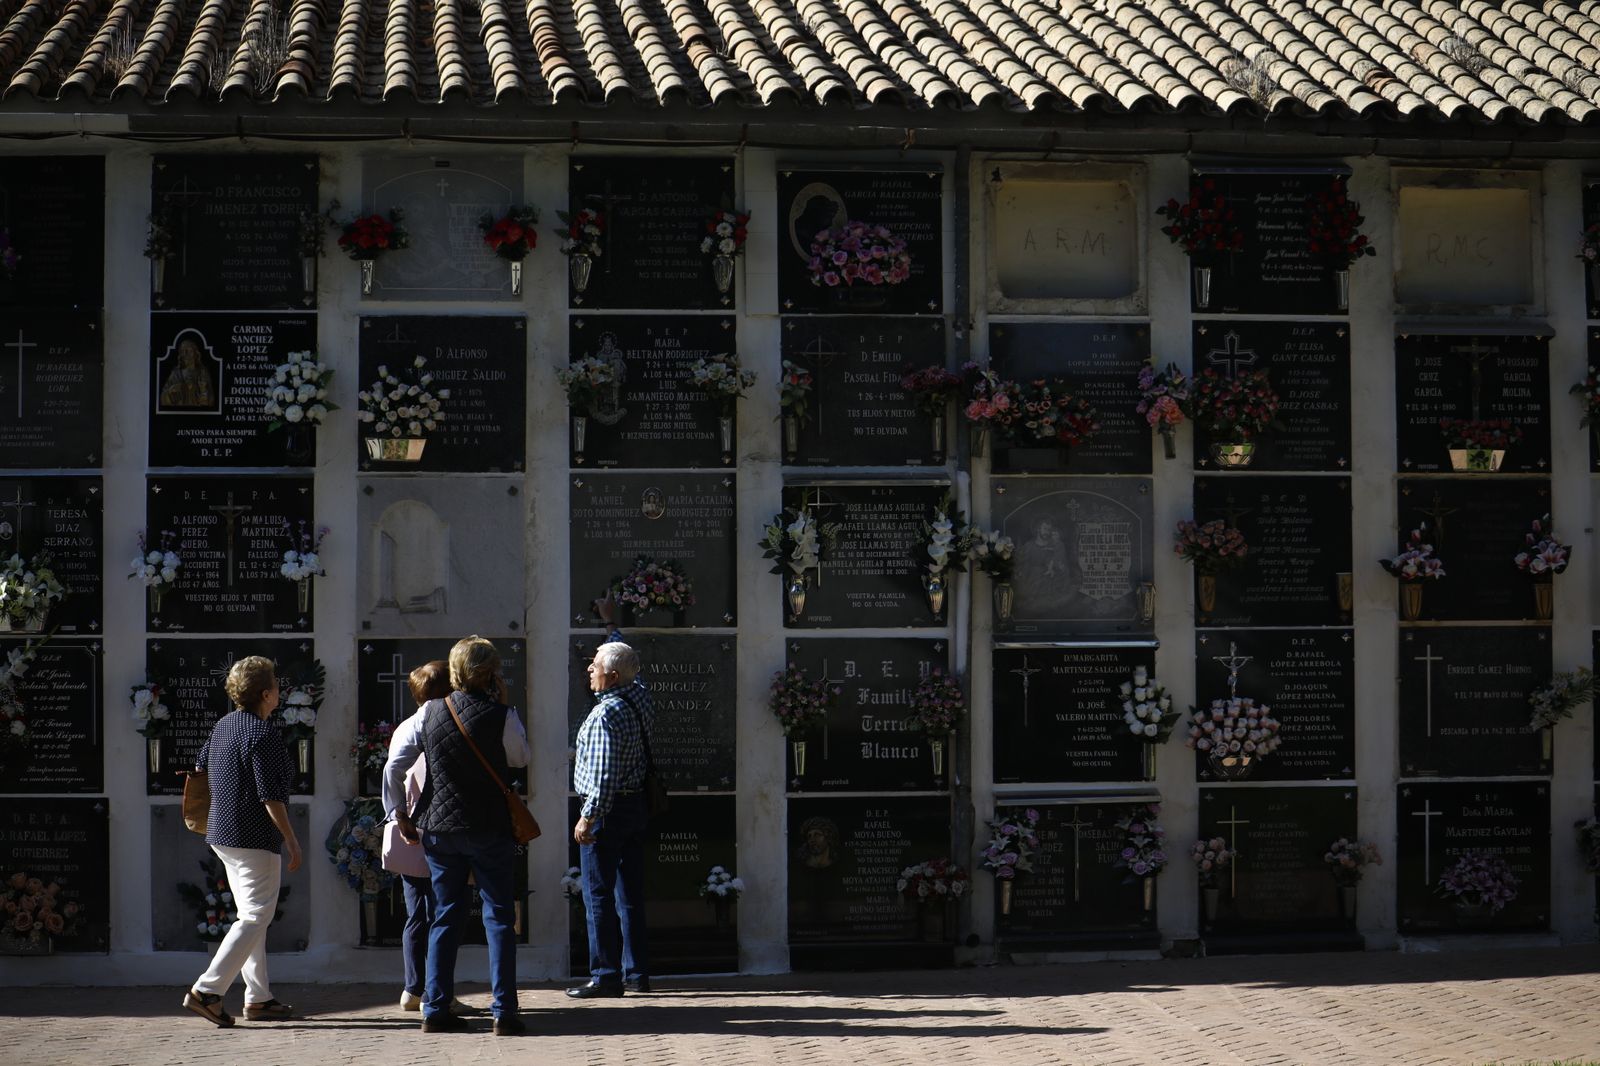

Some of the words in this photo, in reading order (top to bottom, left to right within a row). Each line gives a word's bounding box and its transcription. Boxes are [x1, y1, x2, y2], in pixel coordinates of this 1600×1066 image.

[228, 187, 301, 197] FRANCISCO
[651, 193, 698, 202] ANTONIO
[205, 204, 257, 215] JIMENEZ
[262, 204, 311, 214] TORRES
[233, 325, 272, 334] CARMEN
[231, 336, 274, 344] SANCHEZ
[655, 339, 680, 347] MARIA
[237, 346, 268, 354] LOPEZ
[1299, 343, 1324, 351] ELISA
[447, 347, 488, 358] ALFONSO
[627, 350, 663, 359] BELTRAN
[665, 350, 710, 359] RODRIGUEZ
[873, 352, 901, 362] EMILIO
[1272, 354, 1300, 362] GANT
[1303, 354, 1336, 362] CASBAS
[1424, 357, 1442, 367] JOSE
[473, 369, 506, 380] SALIDO
[844, 372, 880, 383] PASCUAL
[1419, 372, 1439, 382] CRUZ
[627, 392, 674, 401] SAMANIEGO
[1502, 388, 1531, 397] MOLINA
[891, 409, 916, 418] NIETOS
[854, 427, 864, 435] NO
[867, 427, 875, 435] TE
[877, 427, 907, 435] OLVIDAN
[591, 496, 624, 505] MANUEL
[668, 496, 694, 505] MARIA
[696, 496, 733, 505] CATALINA
[667, 508, 709, 517] RODRIGUEZ
[712, 508, 733, 517] SOTO
[846, 504, 862, 512] JOSE
[864, 504, 893, 512] LLAMAS
[896, 504, 925, 512] AGUILAR
[47, 509, 88, 518] TERESA
[573, 509, 593, 517] SOTO
[595, 509, 640, 517] DOMINGUEZ
[265, 516, 287, 524] LUISA
[55, 524, 80, 533] DIAZ
[867, 522, 896, 530] LLAMAS
[182, 528, 208, 536] PEREZ
[44, 538, 93, 546] SERRANO
[841, 541, 857, 549] JOSE
[859, 541, 888, 549] LLAMAS
[185, 594, 219, 602] VUESTROS
[221, 594, 239, 602] HIJOS
[252, 594, 275, 602] NIETOS
[1074, 654, 1119, 662] MARGARITA
[649, 664, 716, 674] MANUELA
[1052, 666, 1094, 674] MARTINEZ
[179, 678, 217, 687] RAFAELA
[176, 689, 208, 698] ORTEGA
[857, 688, 912, 705] Famili
[180, 700, 206, 709] VIDAL
[1056, 713, 1086, 721] VALERO
[860, 742, 919, 759] Blanco
[9, 832, 50, 841] RAFAEL
[54, 832, 87, 841] LOPEZ
[660, 832, 698, 840] FAMILIA
[1446, 827, 1491, 837] MARTINEZ
[1493, 827, 1532, 836] GAVILAN
[12, 848, 69, 858] GUTIERREZ
[842, 877, 862, 885] MOYA
[849, 905, 874, 913] BUENO
